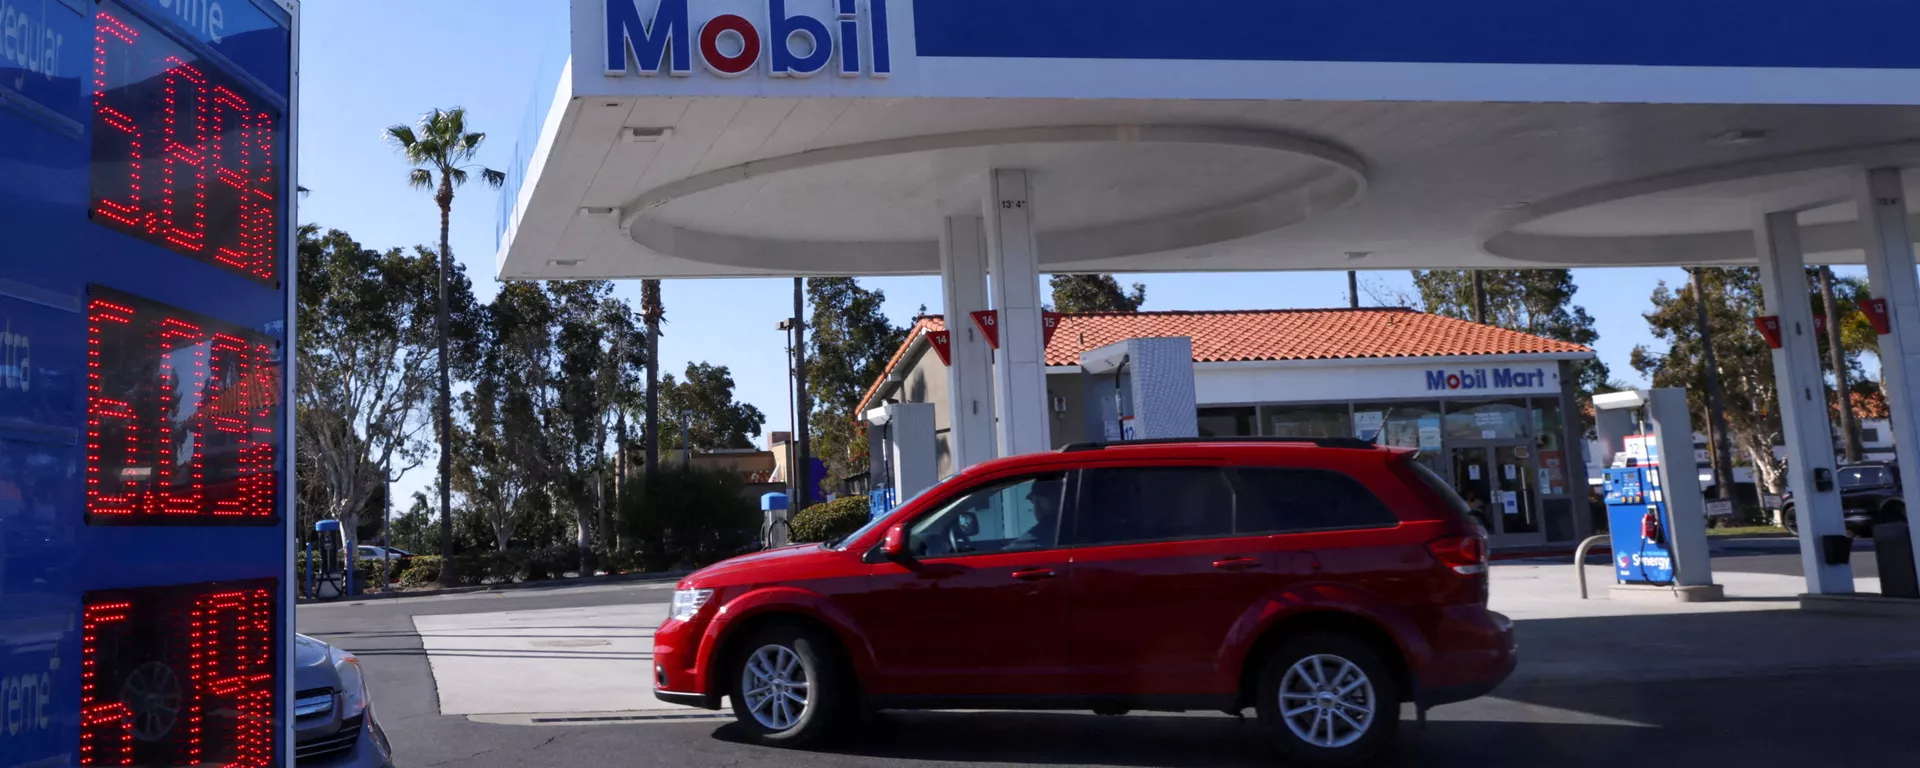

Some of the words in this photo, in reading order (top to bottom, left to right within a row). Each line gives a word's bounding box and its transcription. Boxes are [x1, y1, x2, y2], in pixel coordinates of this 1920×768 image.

[605, 0, 890, 77] Mobil
[0, 0, 63, 91] egular
[1874, 303, 1884, 313] 12
[982, 315, 994, 326] 16
[1043, 317, 1055, 328] 15
[1814, 318, 1821, 328] 9
[935, 334, 948, 345] 14
[0, 318, 30, 393] tra
[1425, 368, 1487, 390] Mobil
[1492, 367, 1545, 388] Mart
